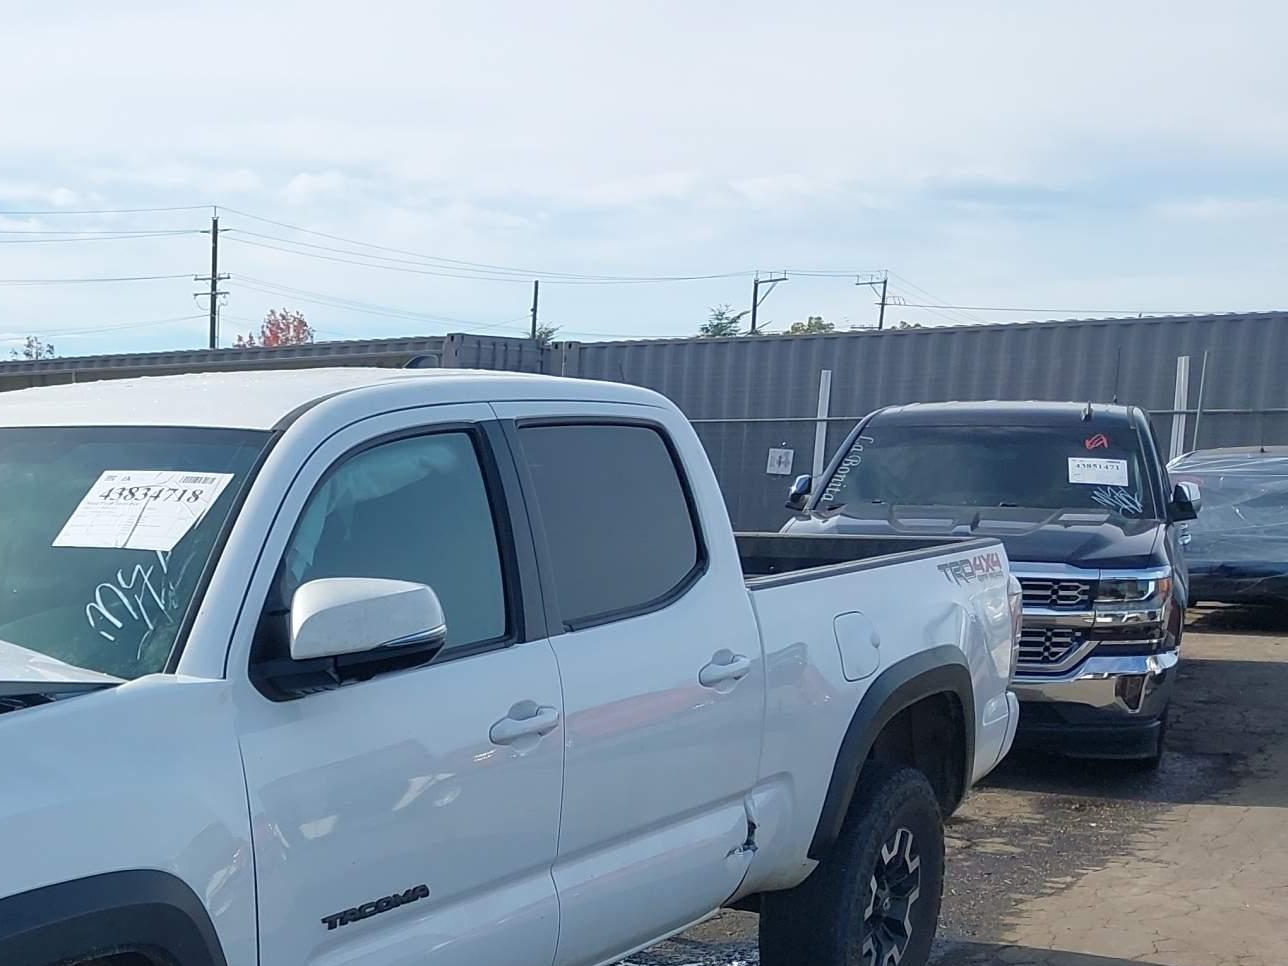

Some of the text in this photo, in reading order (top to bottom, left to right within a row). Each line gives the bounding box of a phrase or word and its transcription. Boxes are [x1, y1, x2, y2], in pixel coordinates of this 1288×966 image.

[99, 486, 204, 504] 43834718
[821, 454, 862, 502] Bonita
[320, 883, 431, 930] TACOMA
